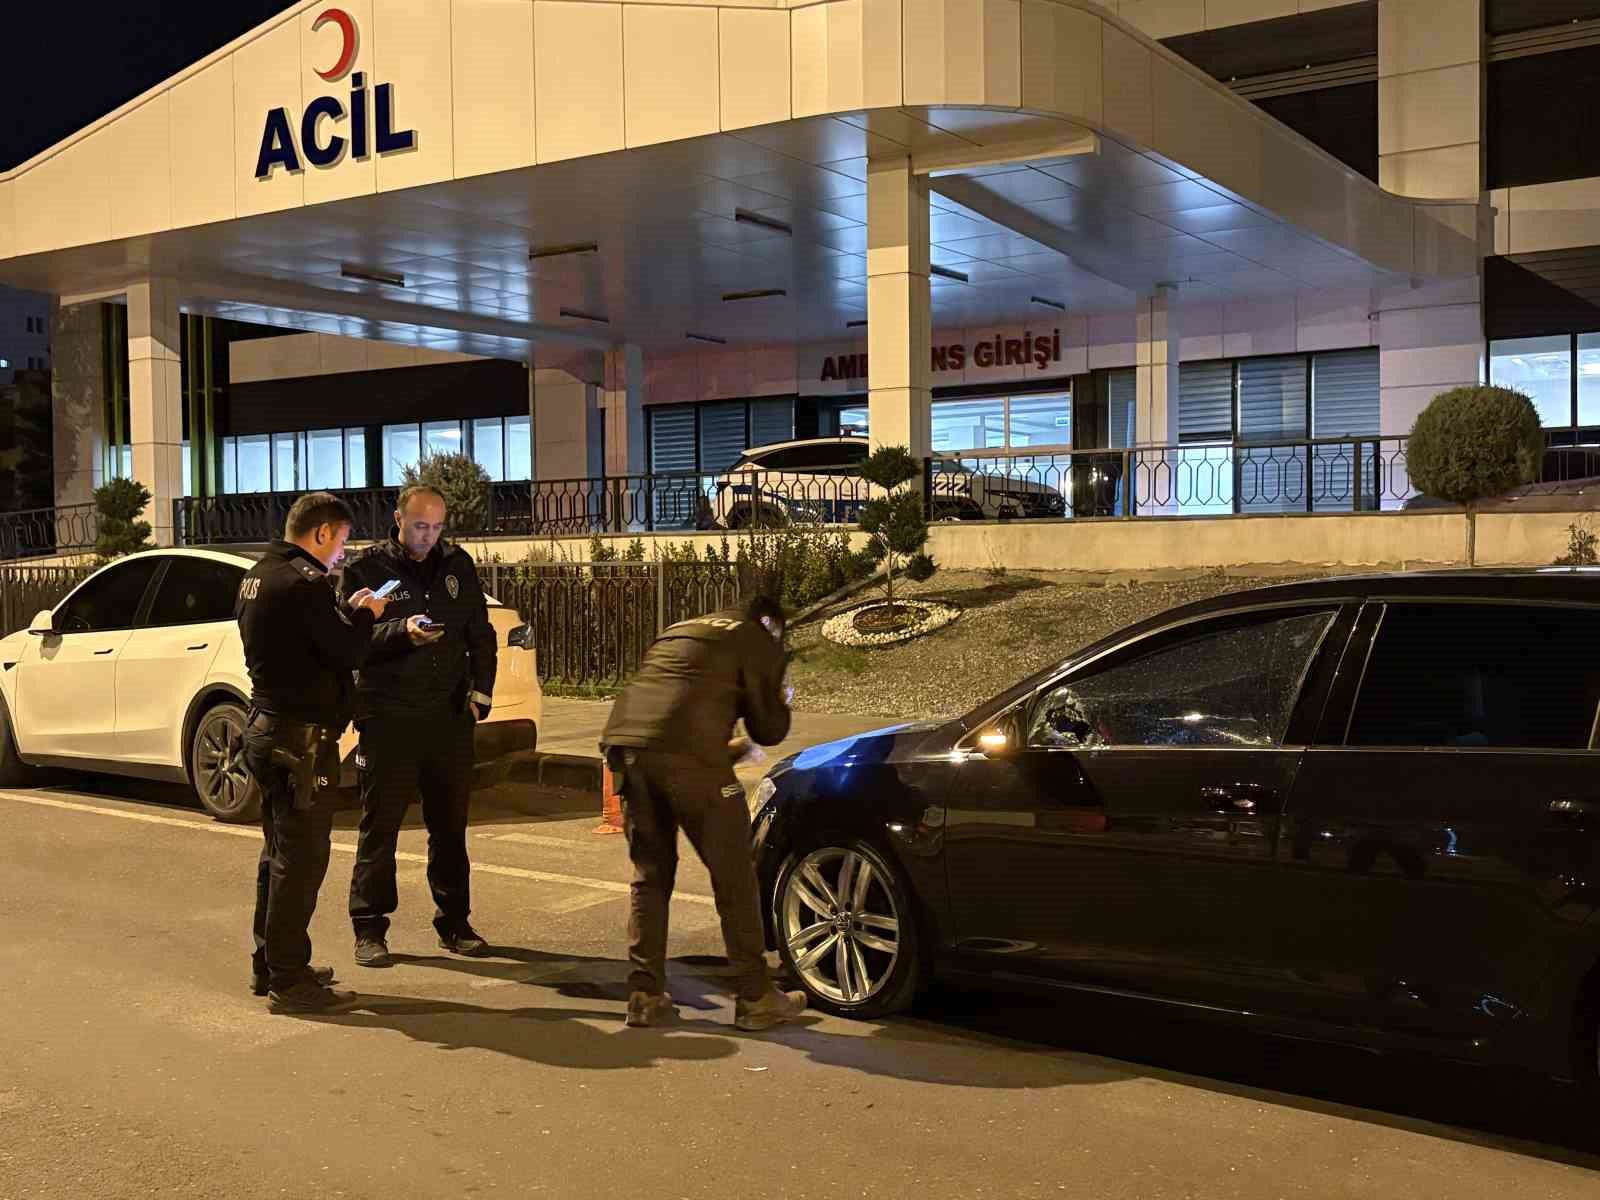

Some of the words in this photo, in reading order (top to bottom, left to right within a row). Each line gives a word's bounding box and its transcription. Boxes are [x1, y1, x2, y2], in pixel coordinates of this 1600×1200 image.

[255, 71, 417, 181] ACİL
[820, 344, 965, 381] AMNS
[974, 328, 1061, 370] GİRİŞİ
